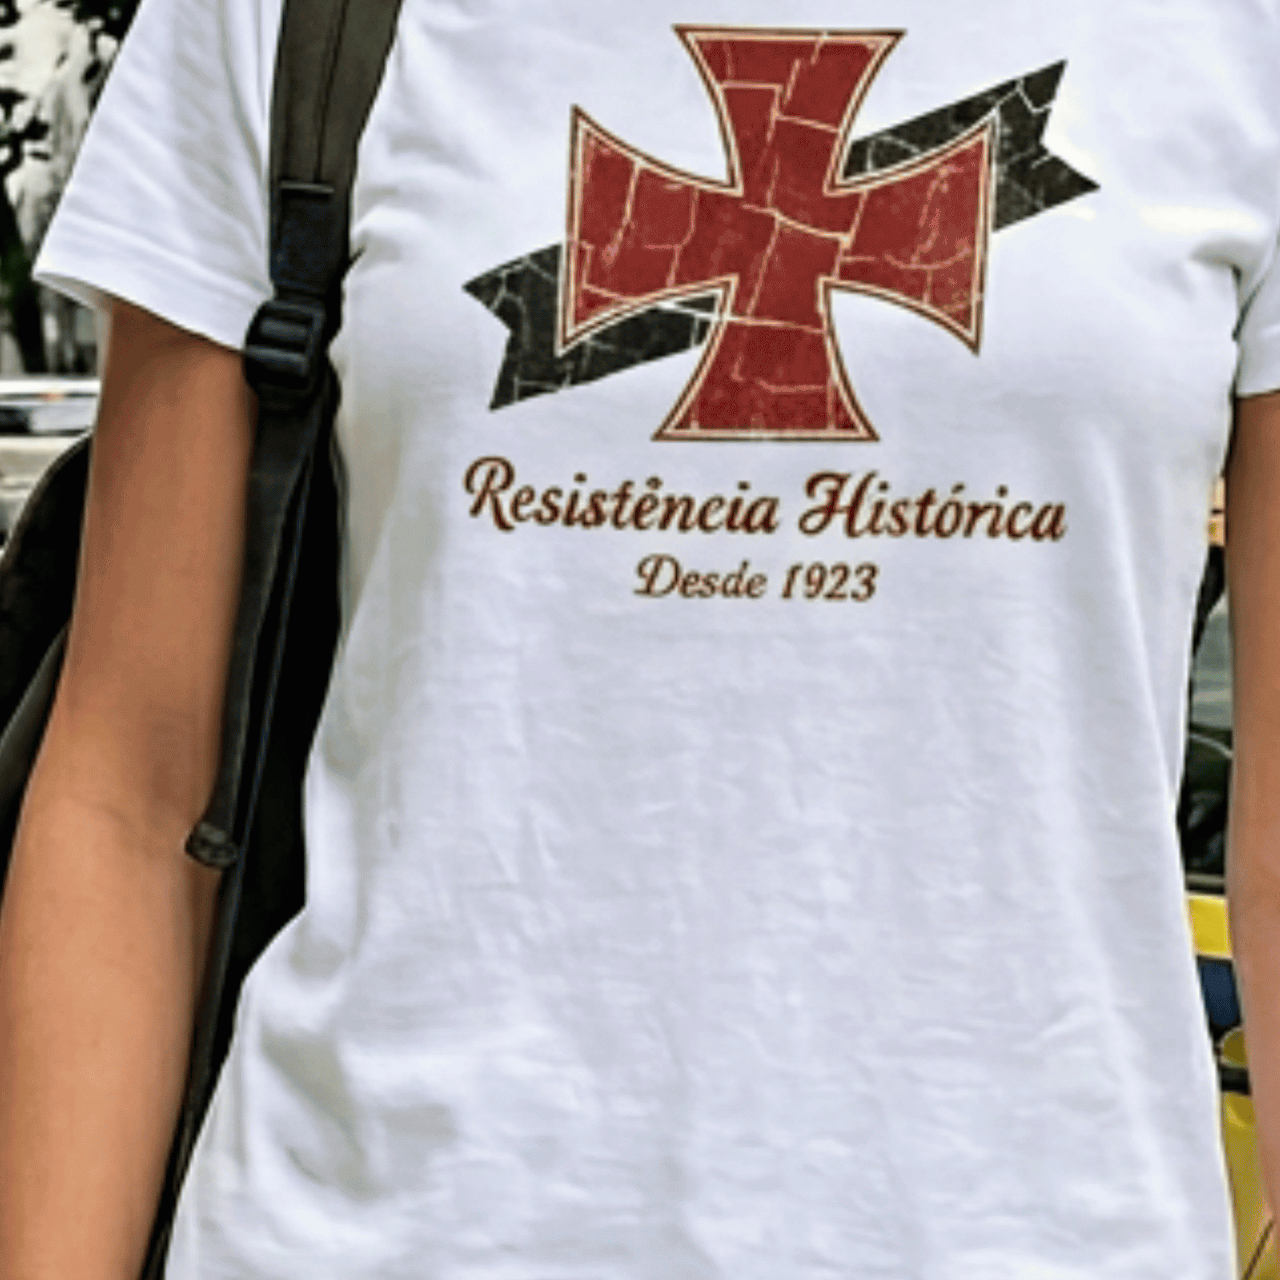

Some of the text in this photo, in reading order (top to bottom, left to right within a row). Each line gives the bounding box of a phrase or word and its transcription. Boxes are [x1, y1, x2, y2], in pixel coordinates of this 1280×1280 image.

[464, 455, 1067, 542] Resistência Histórica
[634, 553, 878, 602] Desde 1923
